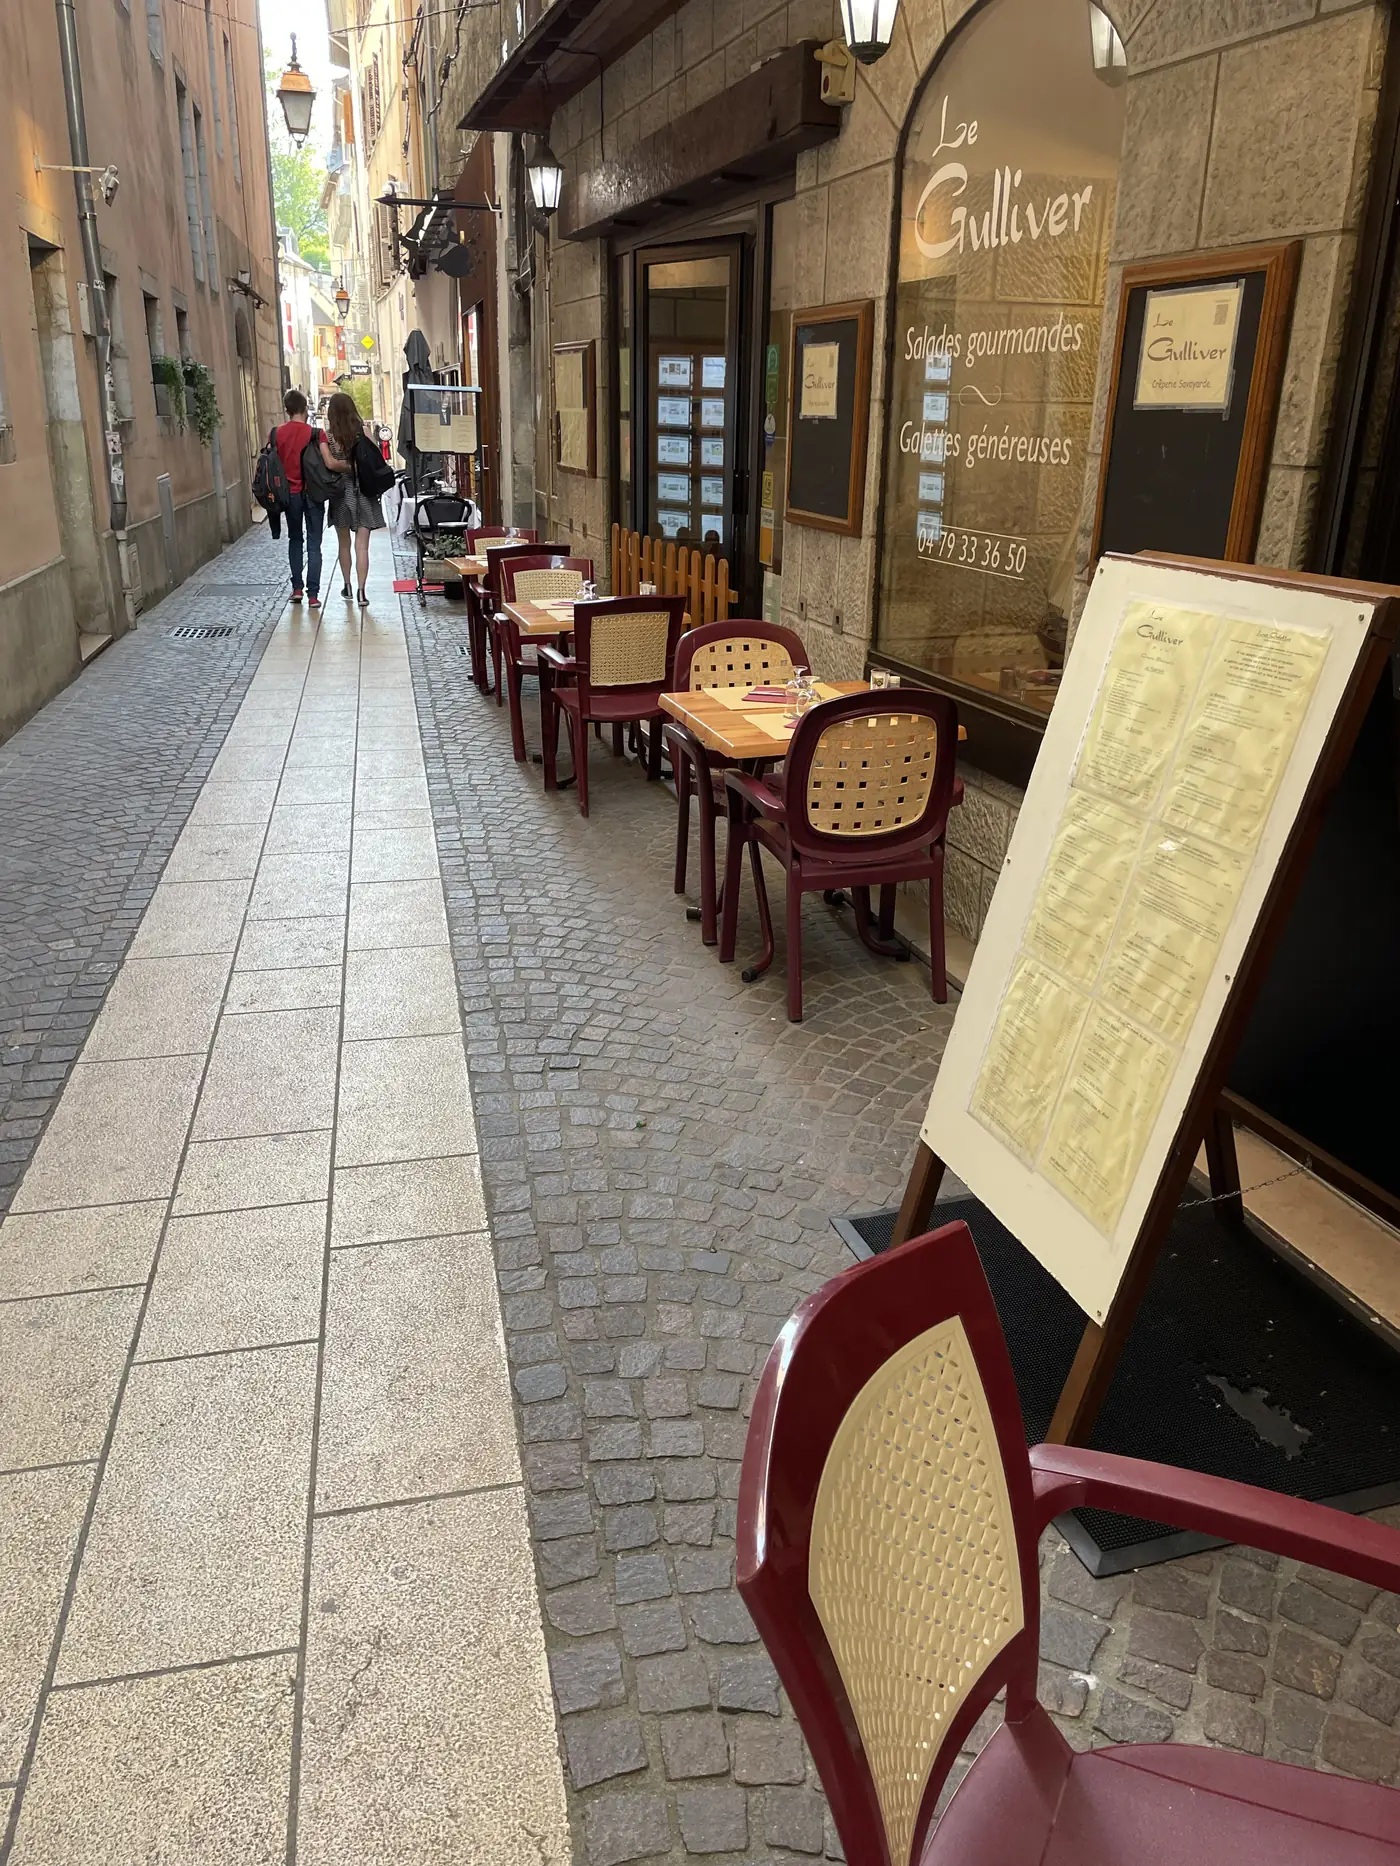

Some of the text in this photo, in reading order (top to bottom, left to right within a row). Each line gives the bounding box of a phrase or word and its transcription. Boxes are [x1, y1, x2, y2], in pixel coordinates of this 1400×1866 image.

[932, 95, 978, 157] Le
[914, 162, 1093, 259] Gulliver
[904, 311, 1084, 368] Salades gourmandes
[1152, 313, 1174, 328] Le
[1147, 336, 1227, 362] Gulliver
[899, 420, 1072, 469] Galettes généreuses
[917, 527, 1027, 574] 04 79 33 36 50
[1136, 624, 1184, 646] Gulliver
